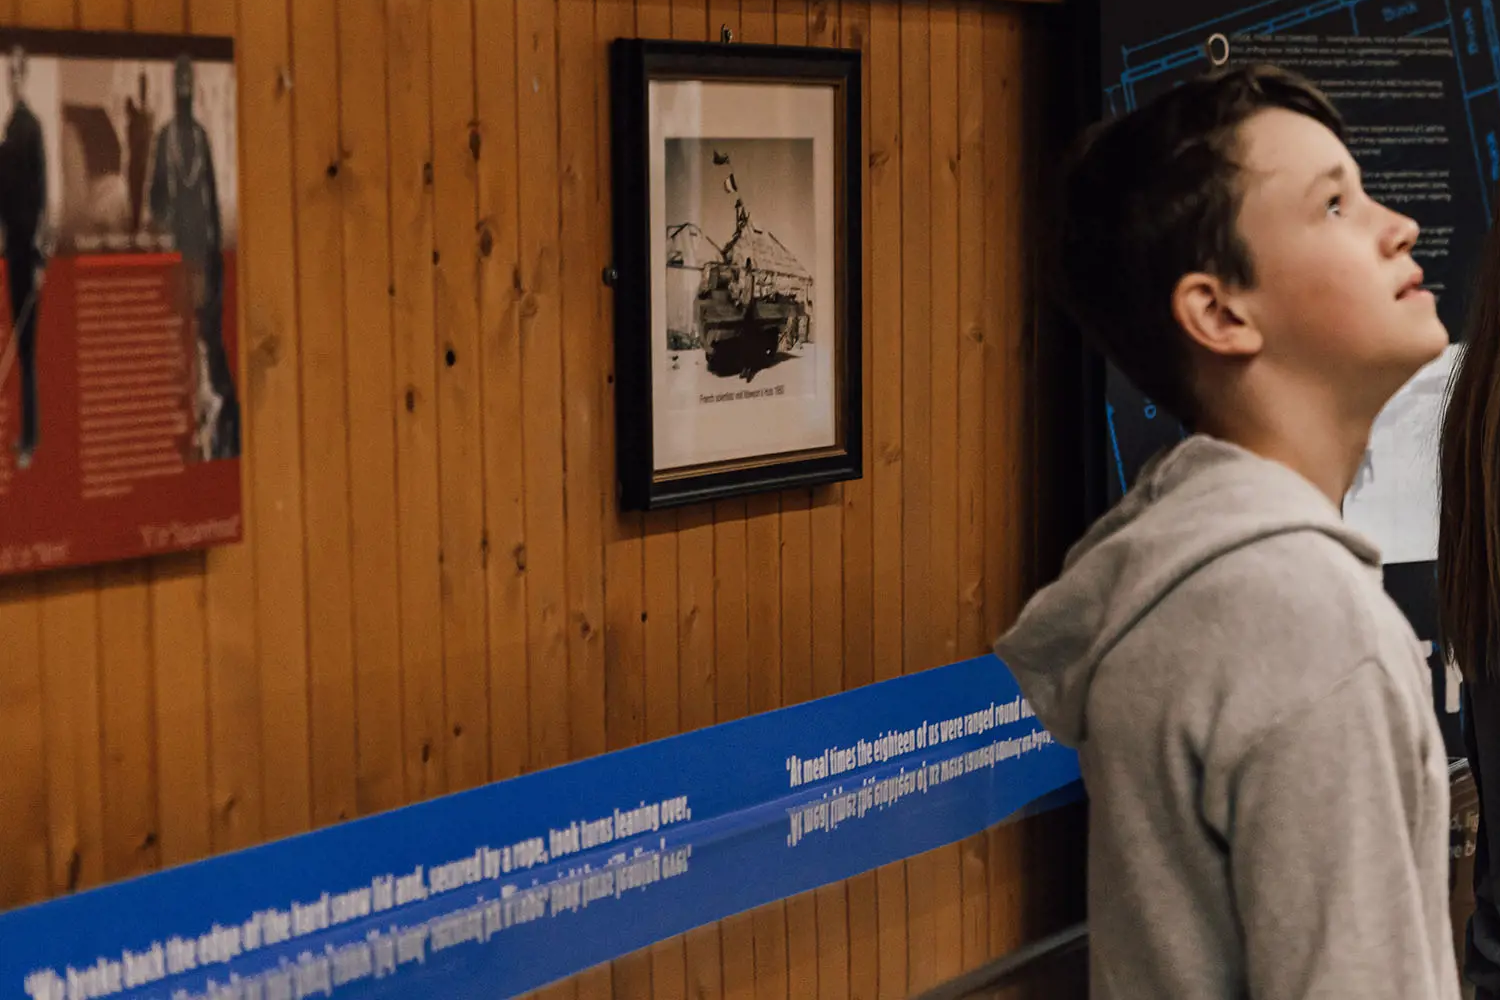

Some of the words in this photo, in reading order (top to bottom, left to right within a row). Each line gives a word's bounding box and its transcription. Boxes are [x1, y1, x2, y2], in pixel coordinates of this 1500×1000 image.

[804, 748, 829, 784] meal
[829, 746, 857, 775] times
[857, 738, 873, 767] the
[873, 729, 916, 763] eighteen
[916, 719, 927, 749] of
[928, 722, 940, 746] us
[940, 717, 963, 743] were
[964, 701, 994, 736] ranged
[995, 695, 1020, 728] round
[614, 800, 660, 839] leaning
